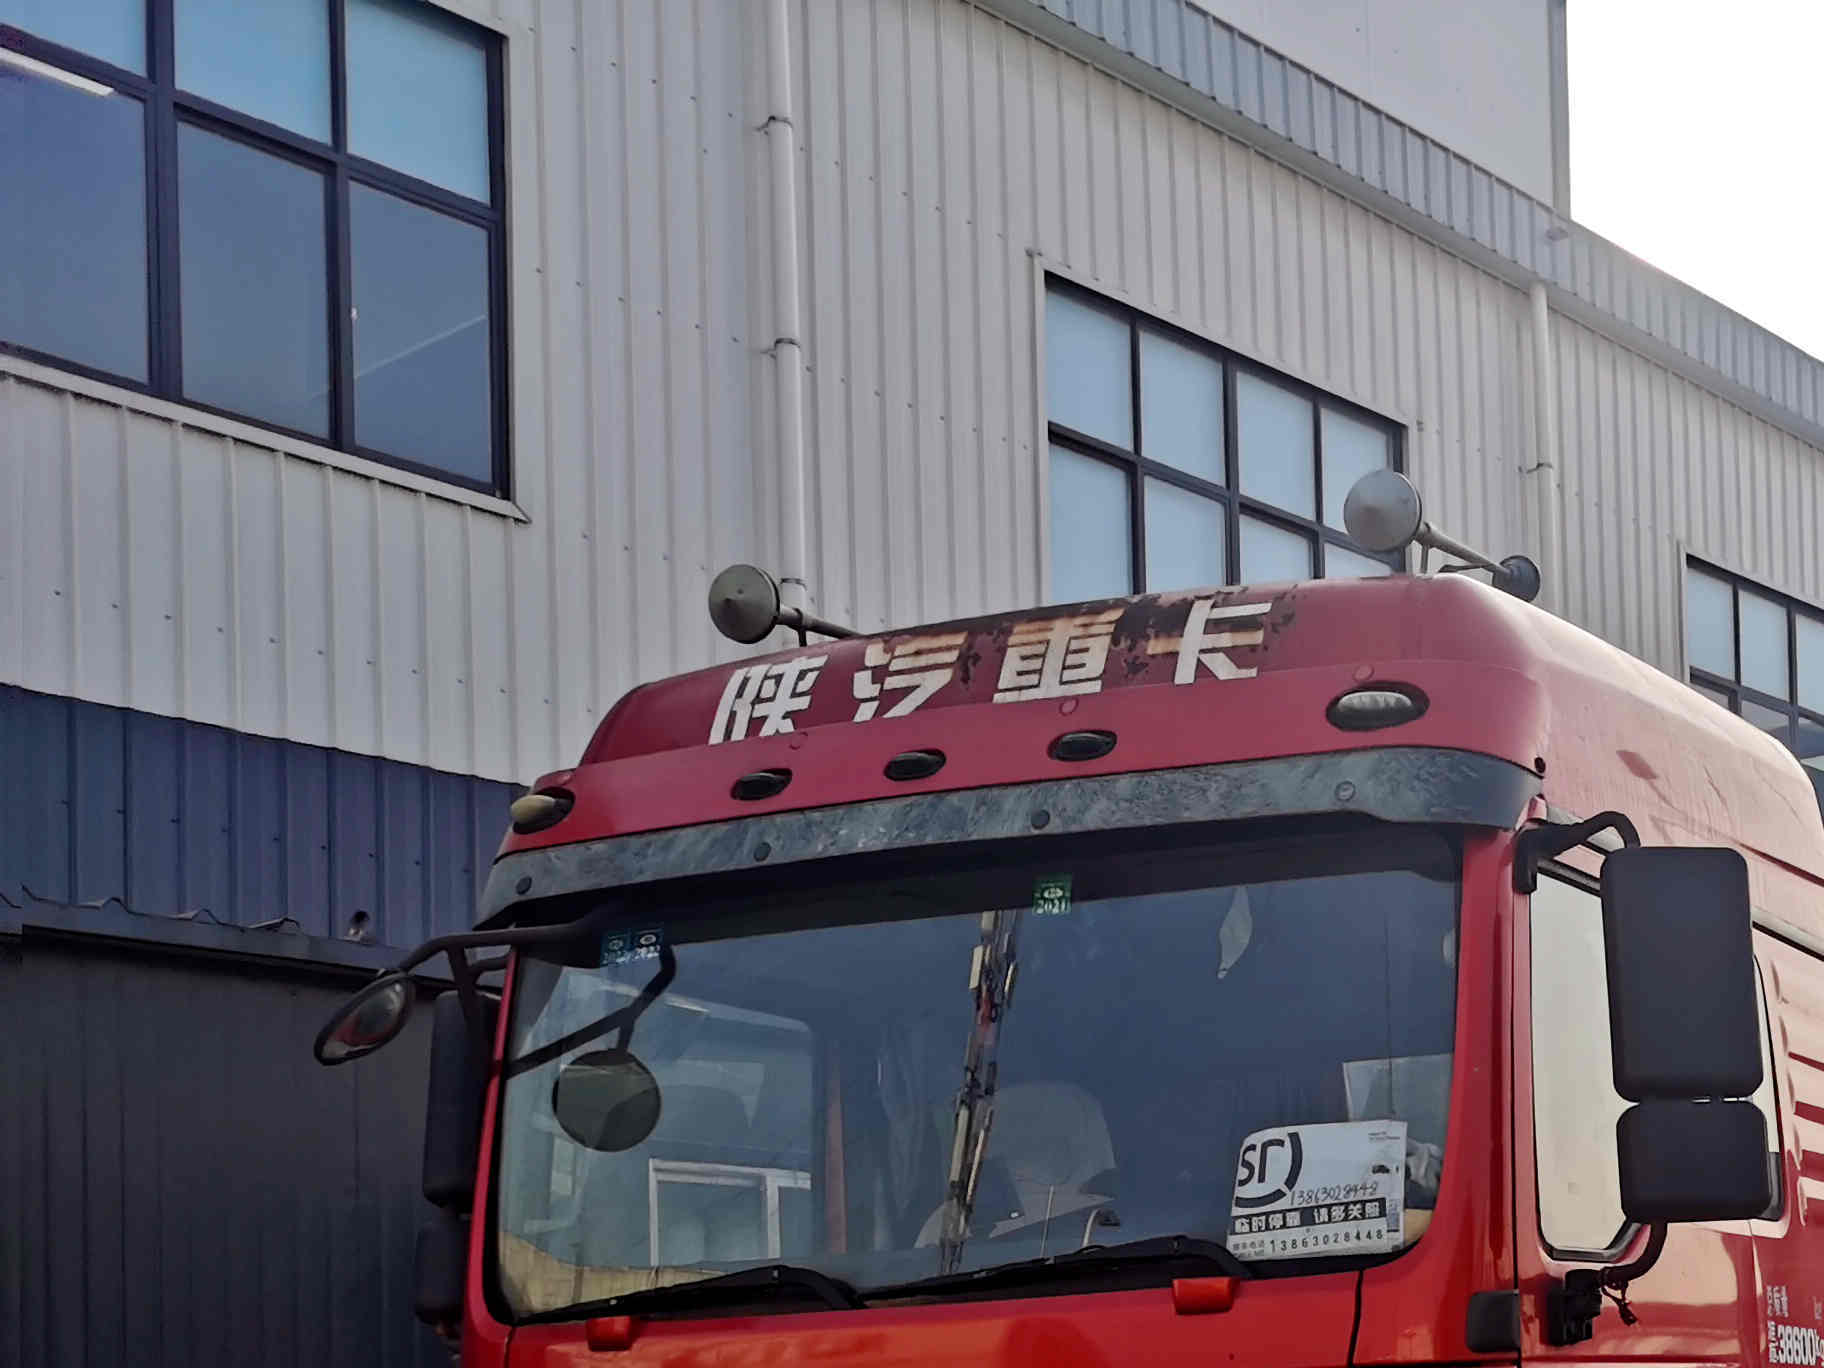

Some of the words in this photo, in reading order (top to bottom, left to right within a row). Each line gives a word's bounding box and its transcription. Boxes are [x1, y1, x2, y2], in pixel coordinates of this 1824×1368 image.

[707, 598, 1273, 746] 陕汽重卡
[1269, 1229, 1384, 1253] 13863028448
